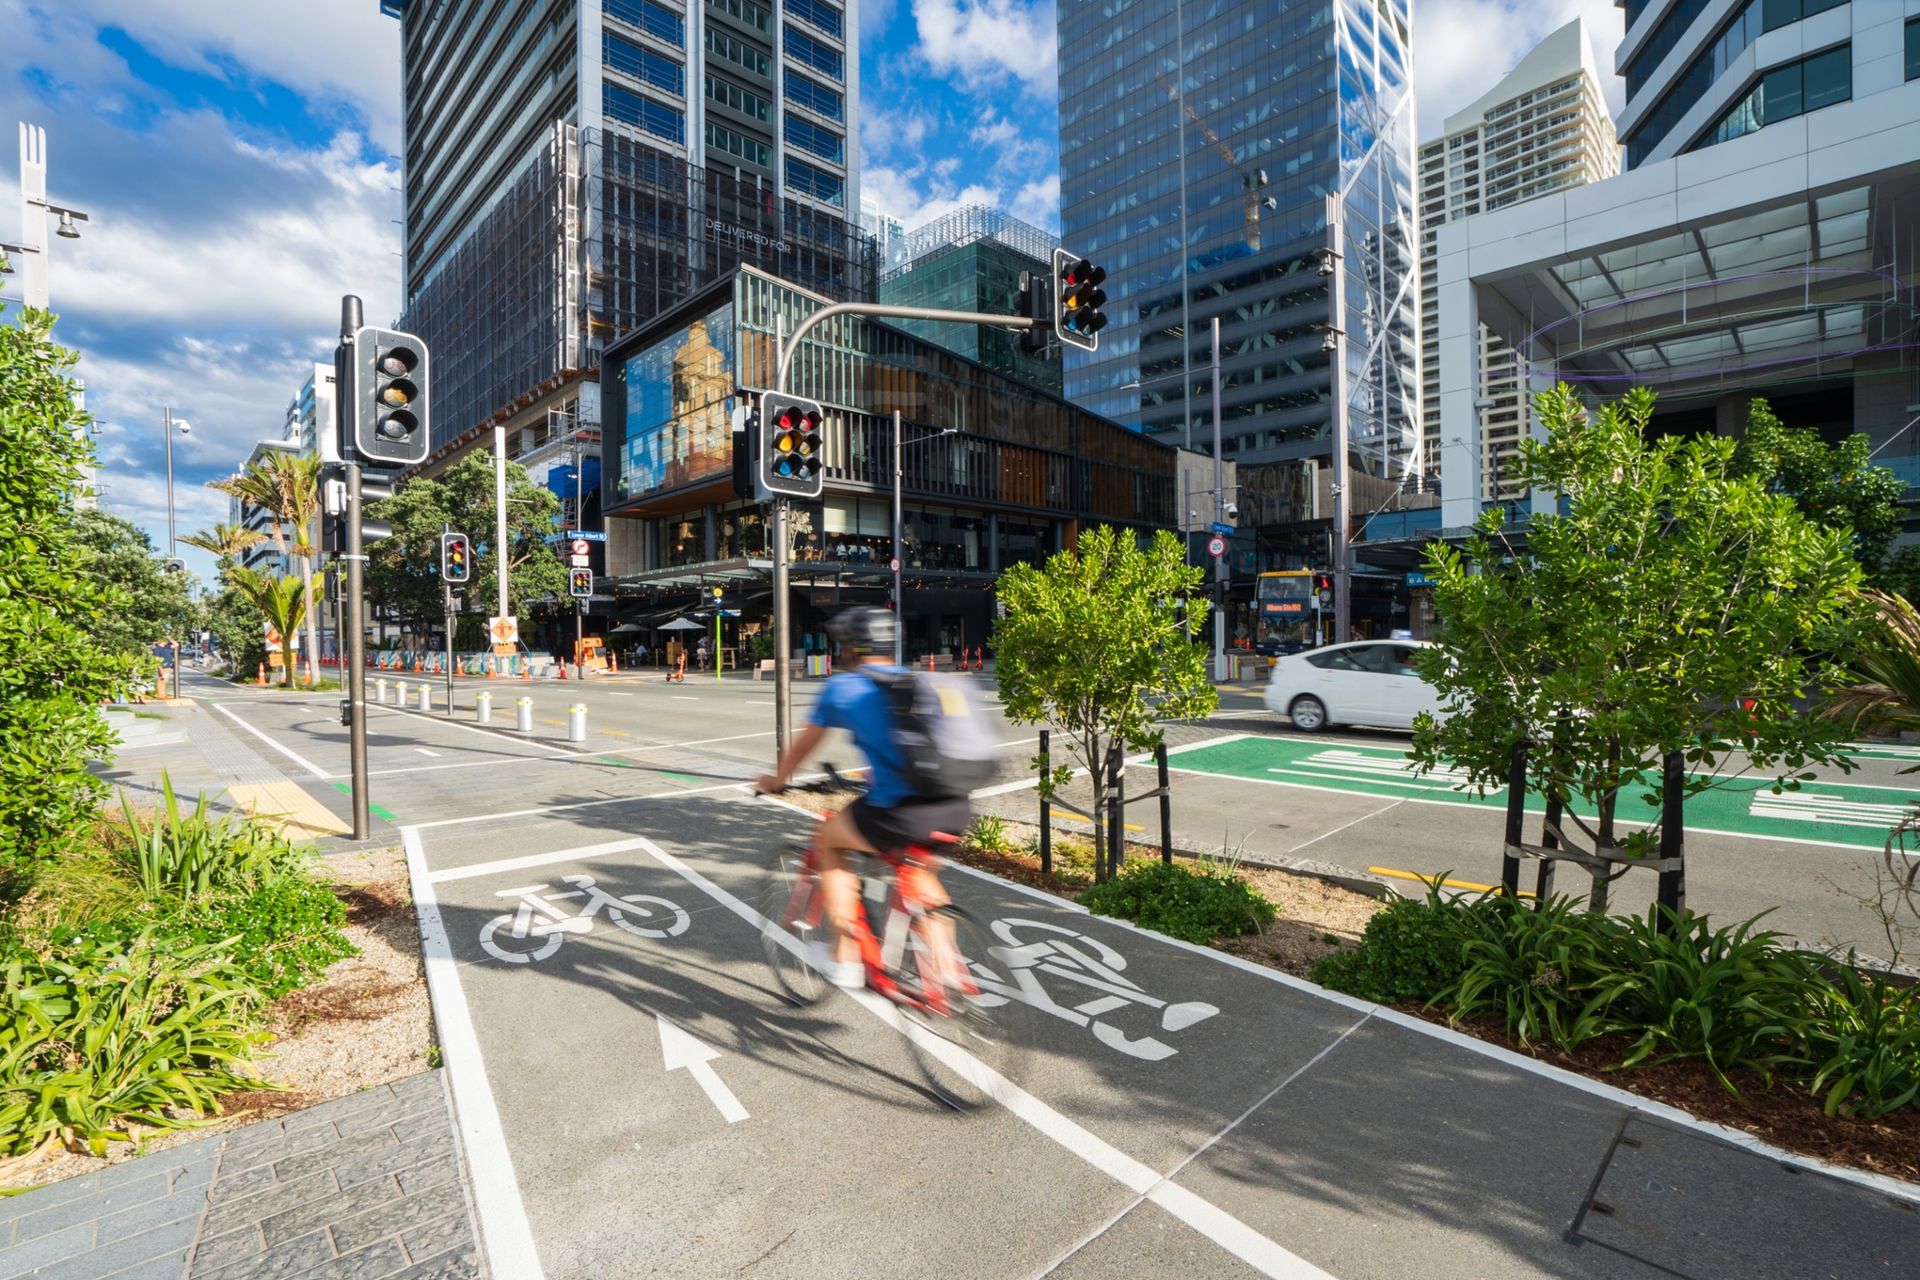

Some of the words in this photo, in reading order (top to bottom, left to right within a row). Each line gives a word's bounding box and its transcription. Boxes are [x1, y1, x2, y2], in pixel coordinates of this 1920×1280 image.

[705, 218, 769, 246] DELIVERED
[769, 239, 791, 254] FOR
[1212, 542, 1222, 551] 20
